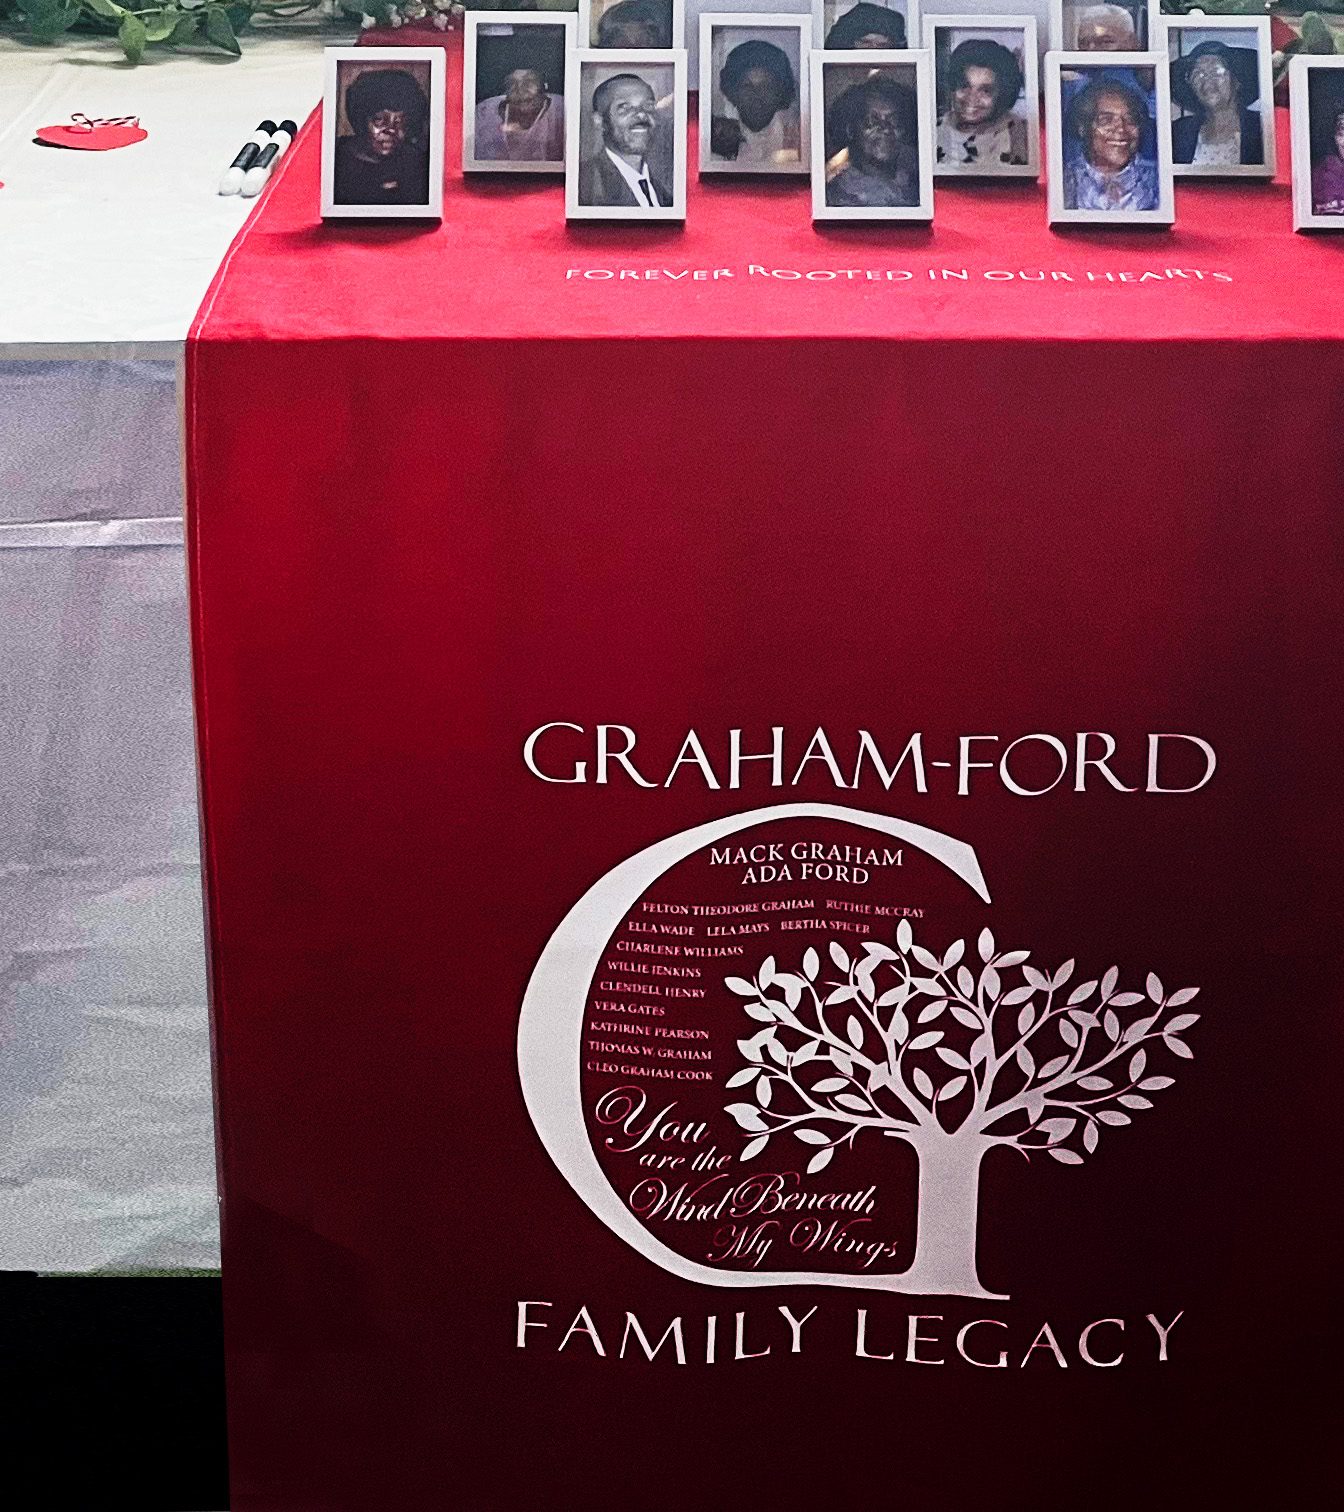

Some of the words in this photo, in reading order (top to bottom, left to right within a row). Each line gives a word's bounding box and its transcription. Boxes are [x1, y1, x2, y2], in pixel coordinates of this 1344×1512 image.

[566, 268, 735, 281] FOREVER
[748, 264, 914, 281] ROOTED
[928, 268, 969, 280] IN
[983, 269, 1075, 282] OUR
[1086, 268, 1234, 282] HEARTS
[522, 721, 1217, 796] GRAHAM-FORD
[709, 843, 785, 866] MACK
[790, 841, 903, 866] GRAHAM
[741, 864, 793, 885] ADA
[800, 863, 869, 885] FORD
[642, 901, 690, 916] FELTON
[692, 901, 760, 916] THEODORE
[761, 899, 816, 913] GRAHAM
[825, 899, 872, 915] RUTHIE
[874, 904, 926, 919] MCCRAY
[628, 921, 659, 934] ELLA
[660, 923, 696, 937] WADE
[707, 924, 736, 937] LELA
[737, 922, 770, 935] MAYS
[780, 919, 828, 931] BERTHA
[829, 920, 871, 935] SPICER
[616, 940, 681, 956] CHARLENE
[683, 945, 745, 958] WILLIAMS
[607, 960, 651, 975] WILLIE
[651, 965, 703, 978] JENKINS
[600, 980, 663, 996] CLENDELL
[664, 987, 708, 999] HENRY
[594, 1000, 626, 1014] VERA
[627, 1003, 666, 1017] GATES
[590, 1021, 652, 1037] KATHRINE
[654, 1027, 711, 1040] PEARSON
[588, 1040, 641, 1055] THOMAS
[657, 1048, 713, 1061] GRAHAM
[586, 1061, 619, 1074] CLEO
[620, 1065, 675, 1081] GRAHAM
[676, 1070, 714, 1081] COOK
[595, 1085, 710, 1153] You
[638, 1153, 687, 1170] are
[690, 1145, 733, 1172] the
[629, 1173, 733, 1222] Wind
[729, 1171, 880, 1218] Beneath
[707, 1219, 782, 1269] My
[788, 1217, 898, 1270] Wings
[515, 1299, 819, 1366] FAMILY
[855, 1308, 1185, 1370] LEGACY
